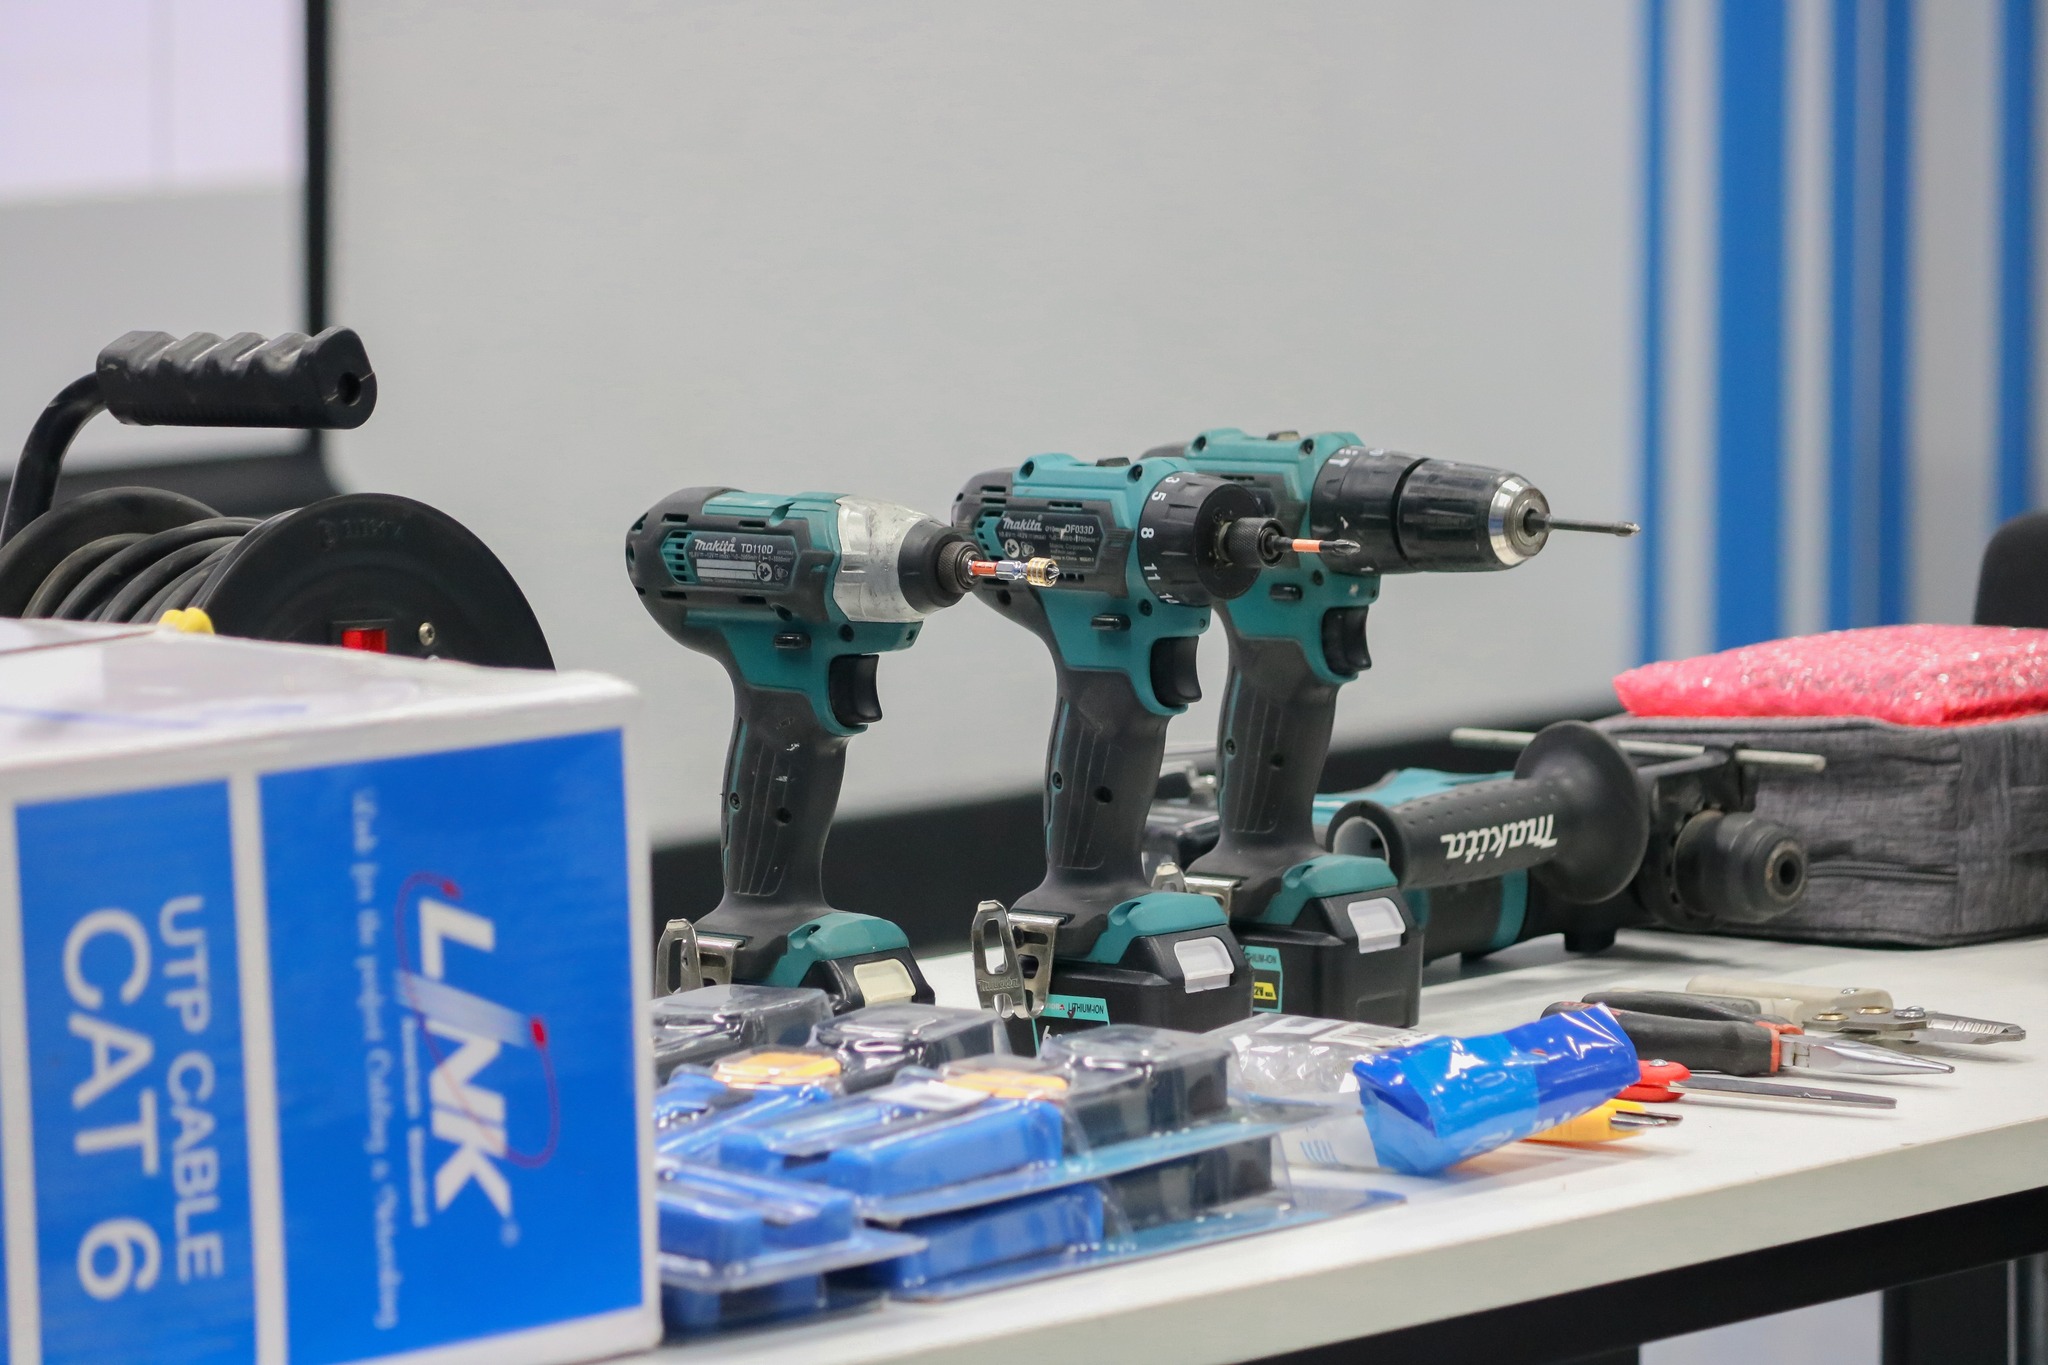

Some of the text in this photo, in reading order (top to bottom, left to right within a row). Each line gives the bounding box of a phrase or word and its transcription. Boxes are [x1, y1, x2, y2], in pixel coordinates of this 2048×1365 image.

[1165, 476, 1180, 484] 3
[1151, 491, 1167, 501] 5
[1065, 524, 1094, 535] DF033D
[1140, 527, 1154, 539] 8
[741, 543, 773, 554] TD110D
[1143, 562, 1161, 581] 11
[1068, 1003, 1104, 1014] LITHIUM-ION
[397, 896, 527, 1217] LINK
[158, 893, 225, 1284] UTP CABLE
[63, 908, 162, 1300] CAT 6
